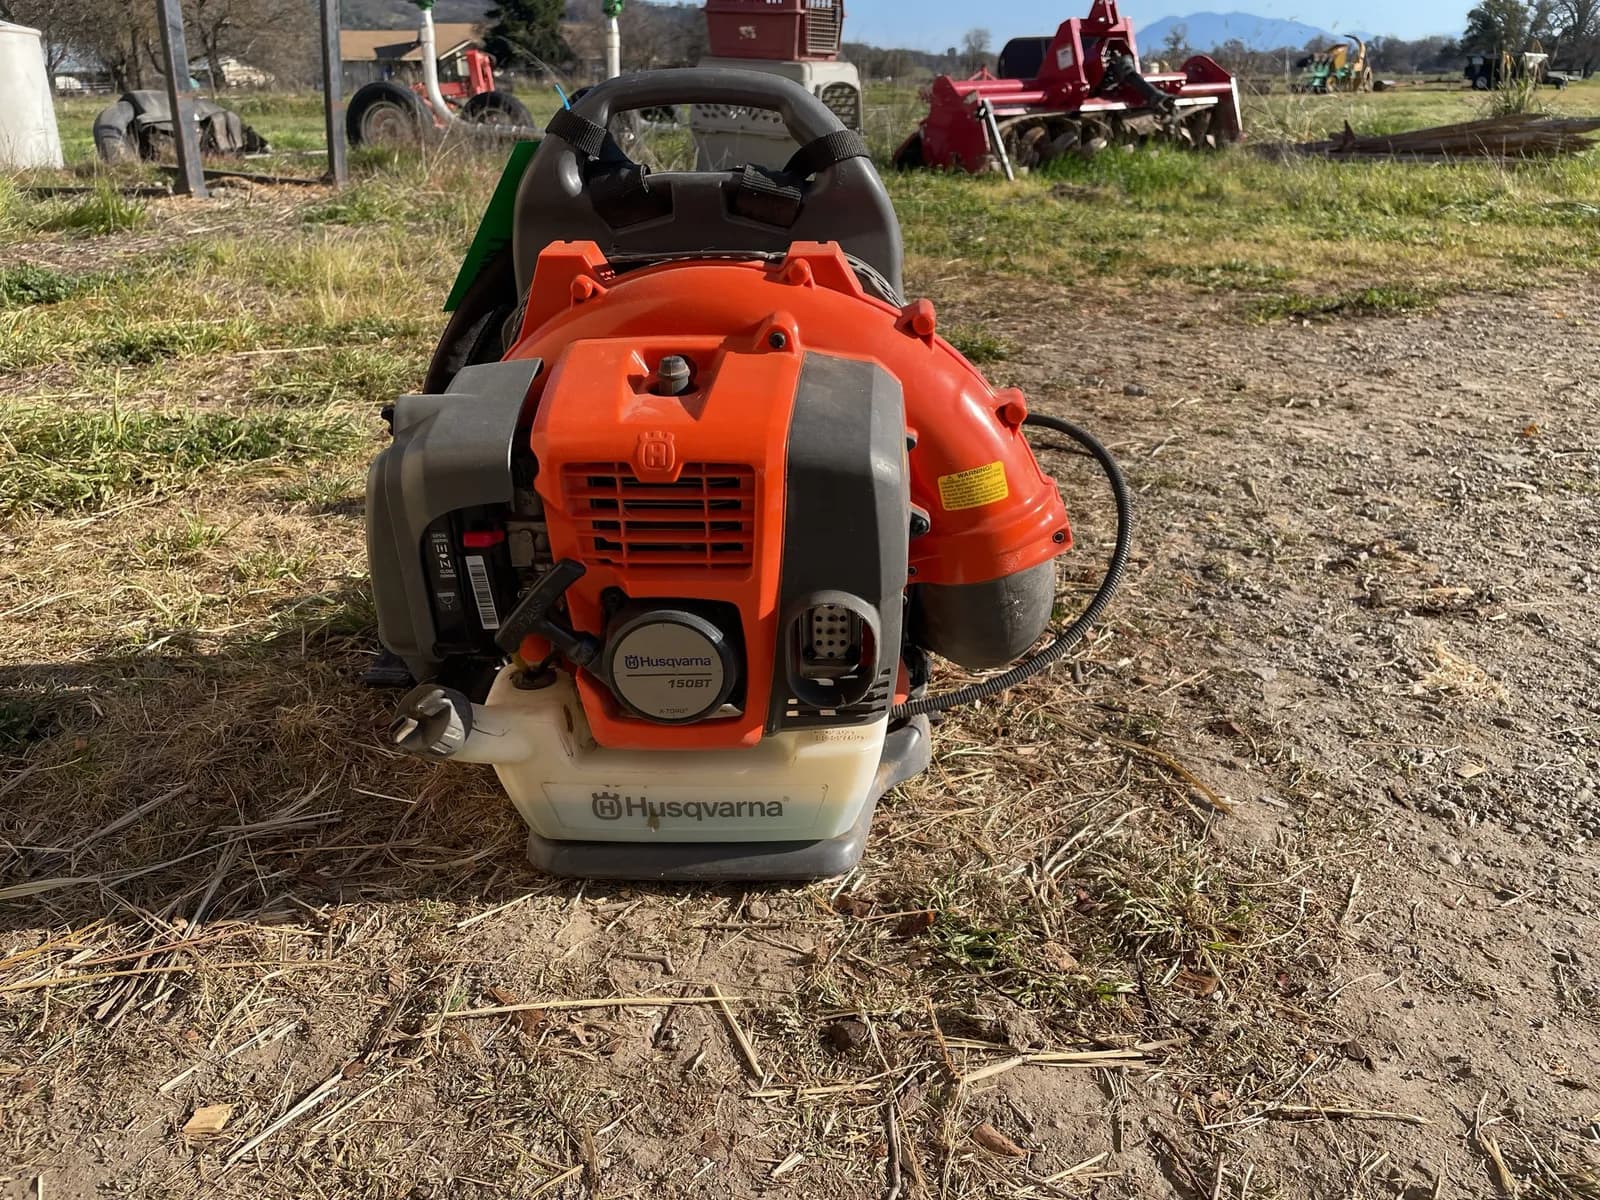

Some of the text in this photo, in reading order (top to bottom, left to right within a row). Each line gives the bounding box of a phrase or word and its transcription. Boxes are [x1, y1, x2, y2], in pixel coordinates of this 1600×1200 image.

[640, 656, 712, 668] Husqvarna
[668, 679, 712, 688] 150BT
[626, 797, 783, 821] Husqvarna
